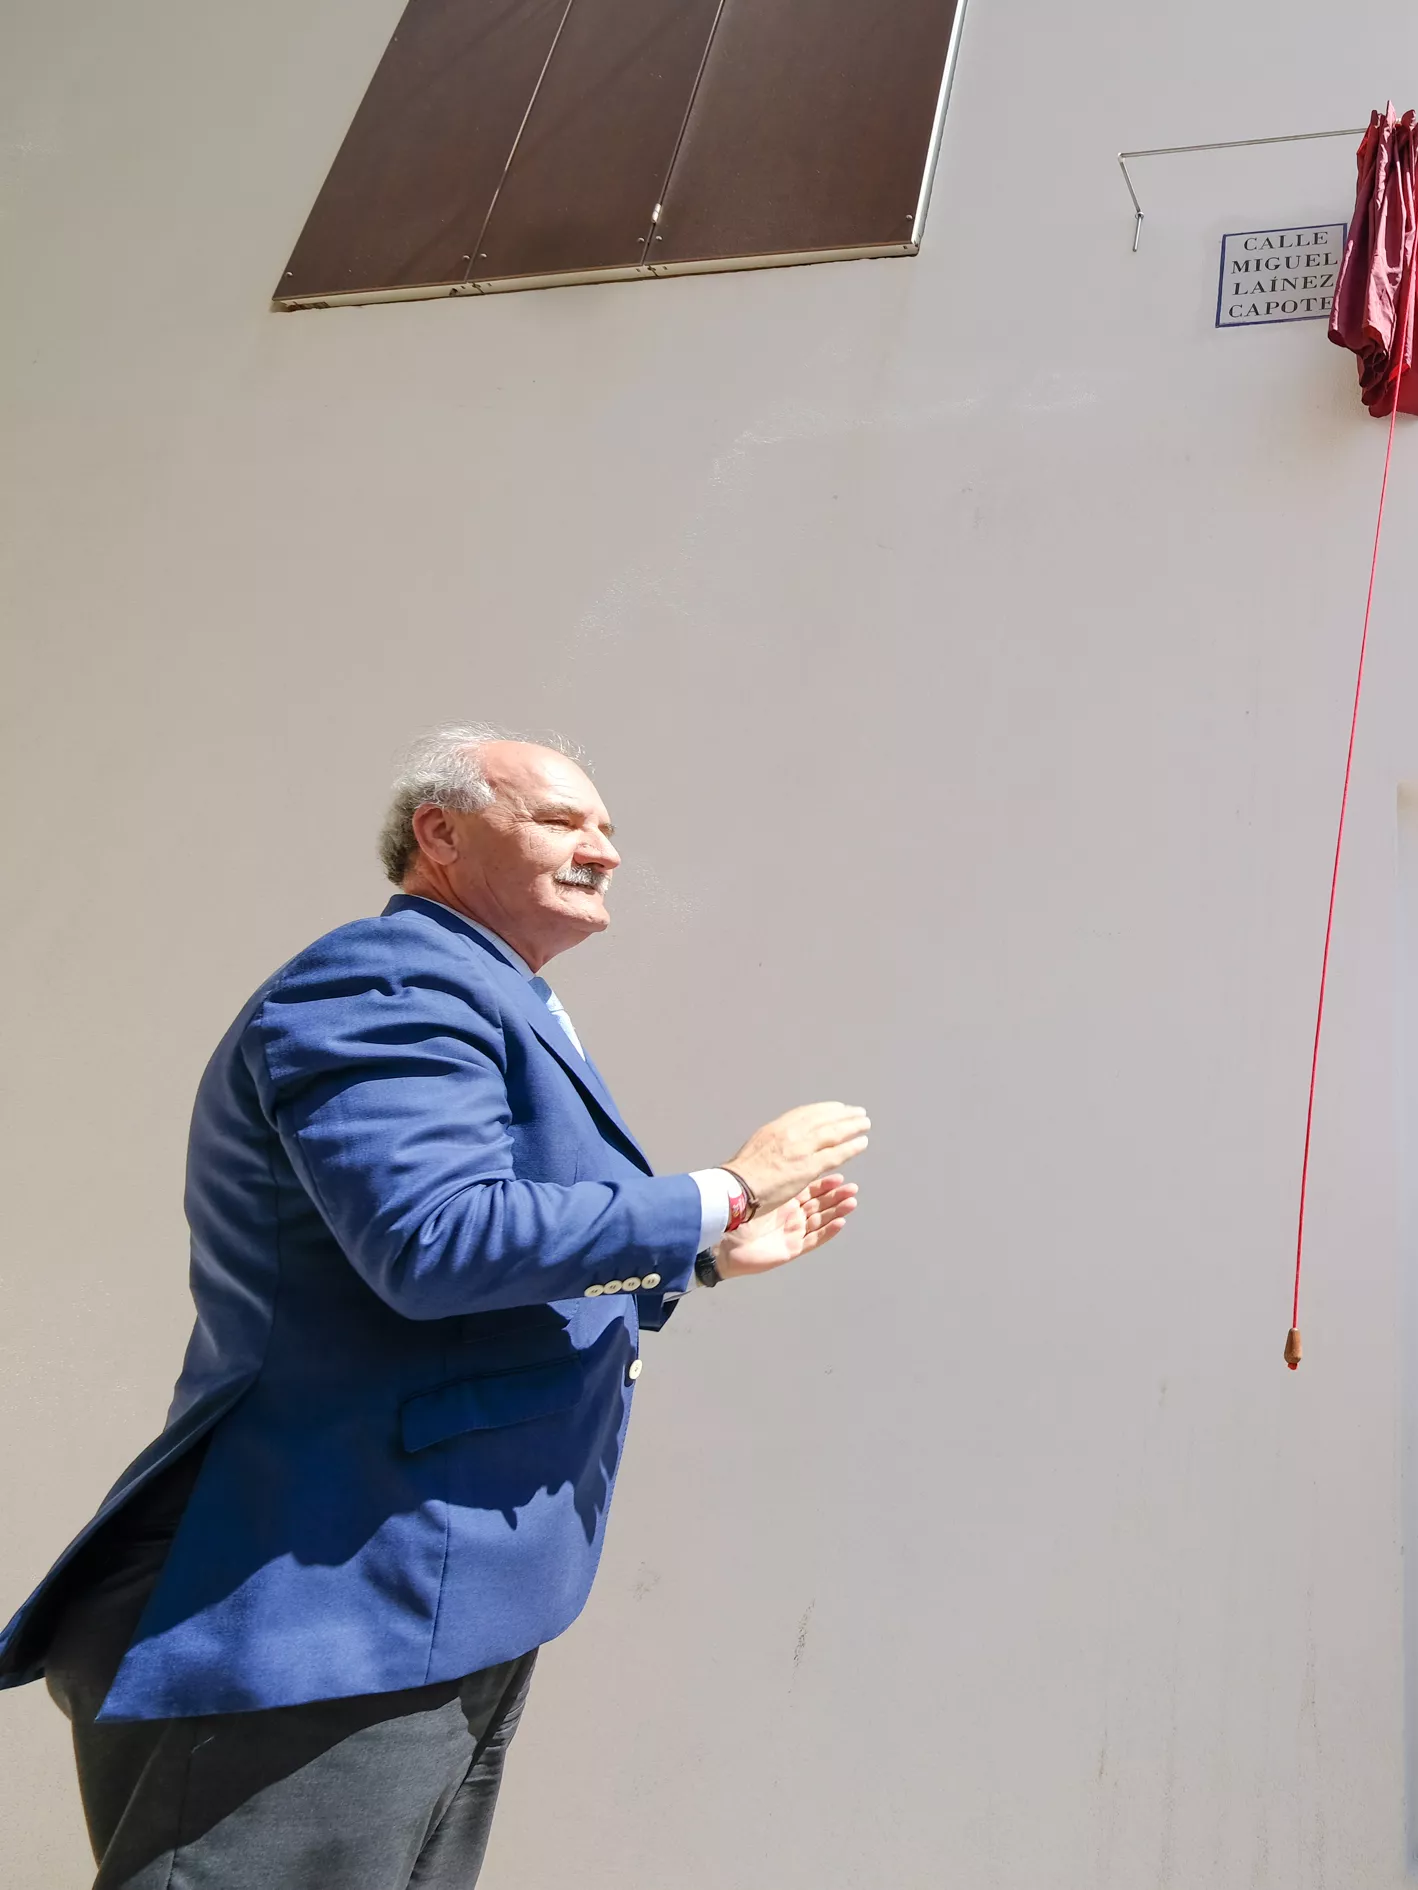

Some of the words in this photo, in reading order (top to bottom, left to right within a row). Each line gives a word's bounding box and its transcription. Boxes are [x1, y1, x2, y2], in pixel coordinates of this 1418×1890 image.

[1243, 231, 1329, 251] CALLE
[1231, 252, 1338, 275] MIGUEL
[1232, 273, 1334, 296] LAÍNEZ
[1228, 296, 1334, 318] CAPOTE
